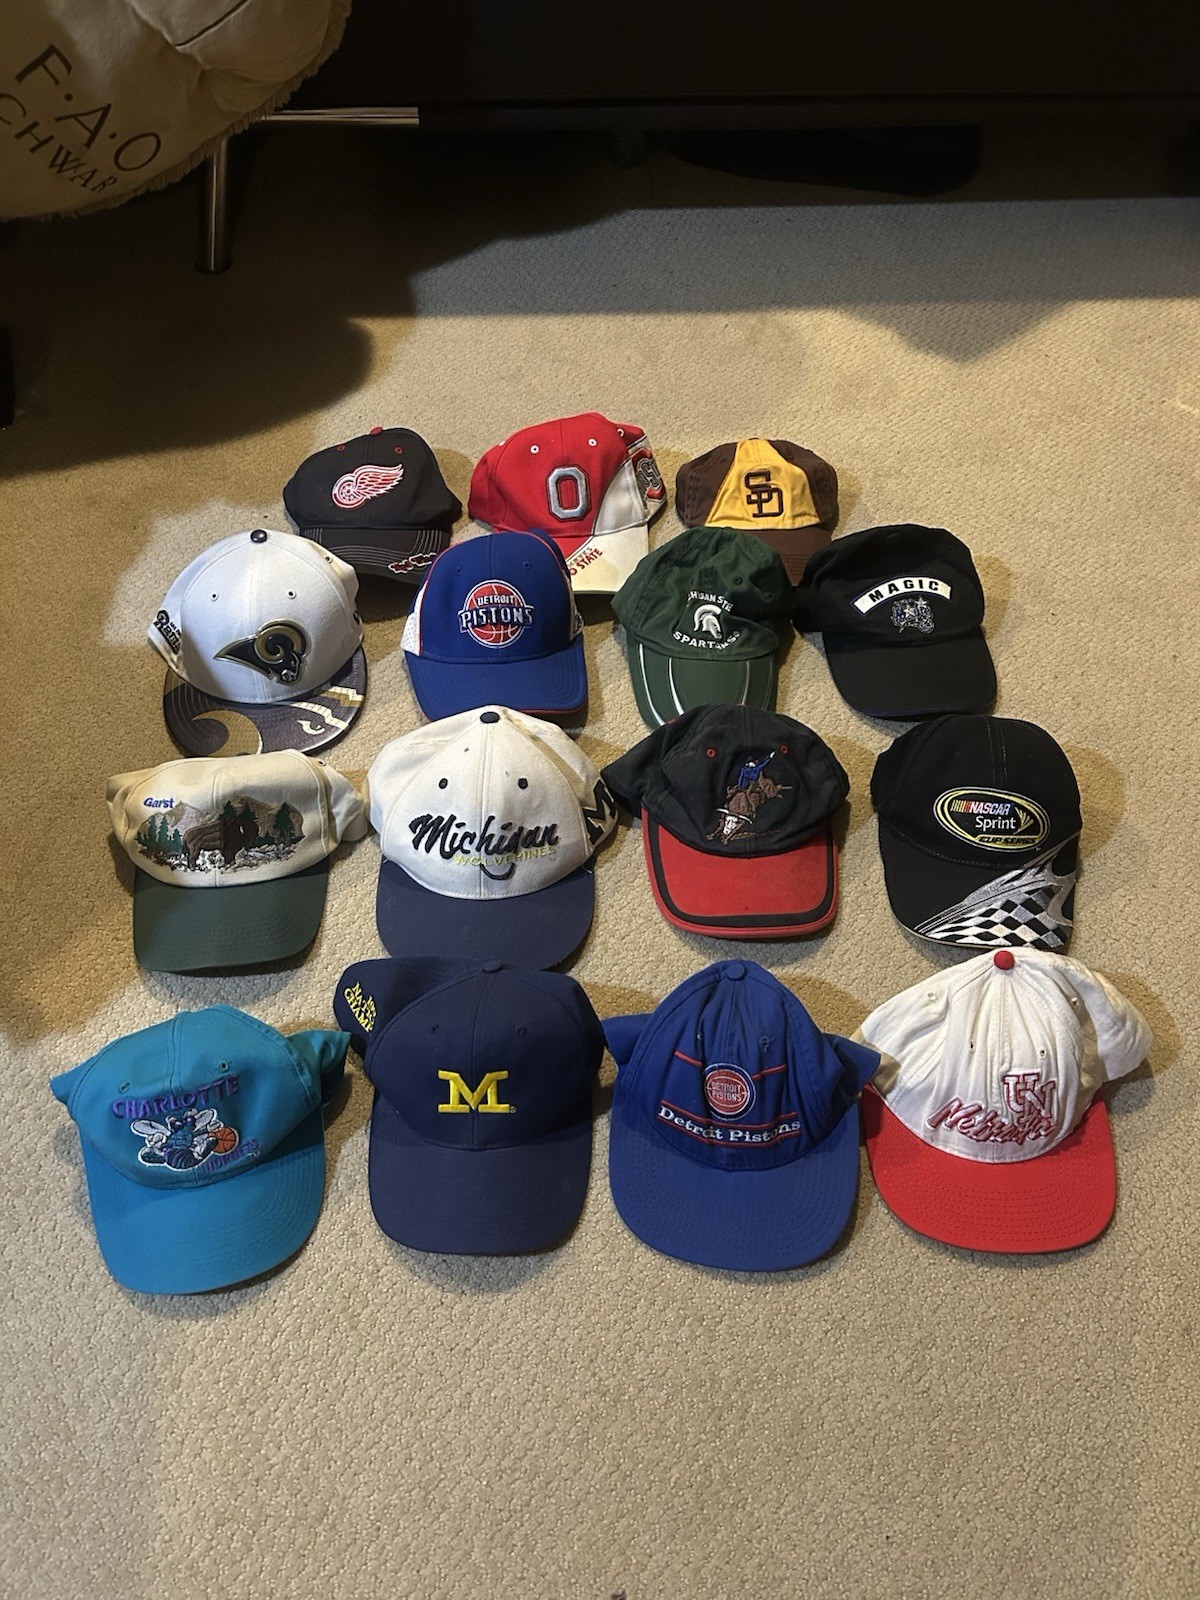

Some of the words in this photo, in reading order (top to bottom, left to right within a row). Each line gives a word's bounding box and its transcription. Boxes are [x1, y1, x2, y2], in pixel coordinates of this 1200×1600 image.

[547, 466, 592, 522] O
[576, 548, 603, 570] STATE
[476, 595, 514, 606] DETROIT
[868, 579, 939, 602] MAGIC
[461, 607, 533, 629] PISTONS
[143, 797, 175, 809] Garst
[969, 800, 1012, 816] NASCAR
[975, 815, 1017, 831] Sprint
[408, 813, 561, 880] Michigan
[454, 847, 556, 866] WOLVERINES
[112, 1074, 241, 1119] CHARLOTTE
[437, 1069, 510, 1113] M
[711, 1081, 741, 1094] DETROIT
[711, 1090, 743, 1102] PISTONS
[657, 1105, 724, 1140] Detroit
[728, 1120, 801, 1142] Pistons
